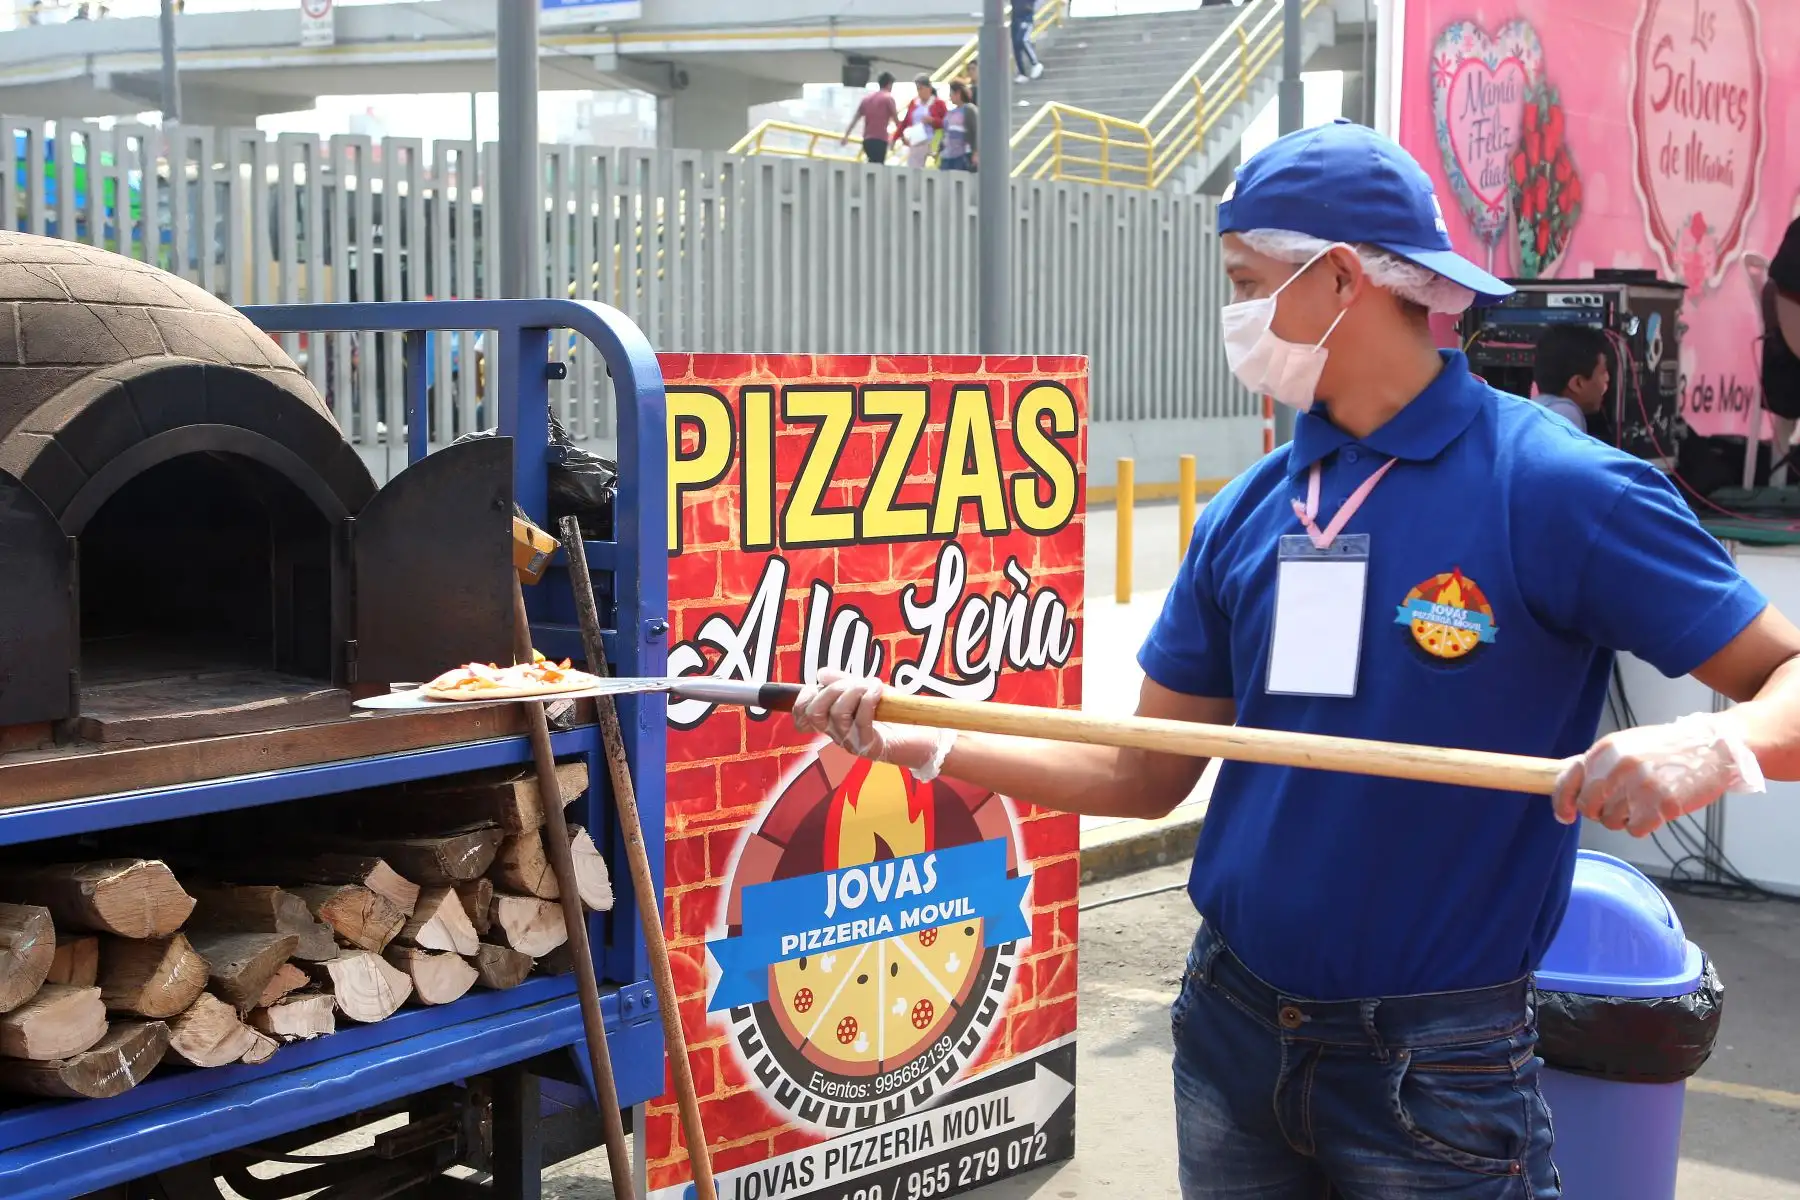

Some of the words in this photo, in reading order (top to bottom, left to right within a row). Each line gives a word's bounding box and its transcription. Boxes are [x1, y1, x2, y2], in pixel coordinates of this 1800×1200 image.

[1460, 68, 1515, 119] Mamá
[1651, 34, 1748, 132] Sabores
[1660, 130, 1680, 179] de
[1691, 374, 1713, 412] de
[1718, 374, 1754, 422] May
[667, 381, 1078, 556] PIZZAS
[801, 578, 884, 685] la
[824, 854, 938, 919] JOVAS
[781, 914, 894, 956] PIZZERIA
[900, 897, 975, 929] MOVIL
[809, 1071, 871, 1099] Eventos:
[875, 1035, 954, 1093] 995682139
[733, 1155, 815, 1200] JOVAS
[825, 1120, 934, 1180] PIZZERIA
[943, 1096, 1015, 1142] MOVIL
[908, 1170, 950, 1200] 955
[958, 1147, 999, 1187] 279
[1007, 1131, 1048, 1171] 072
